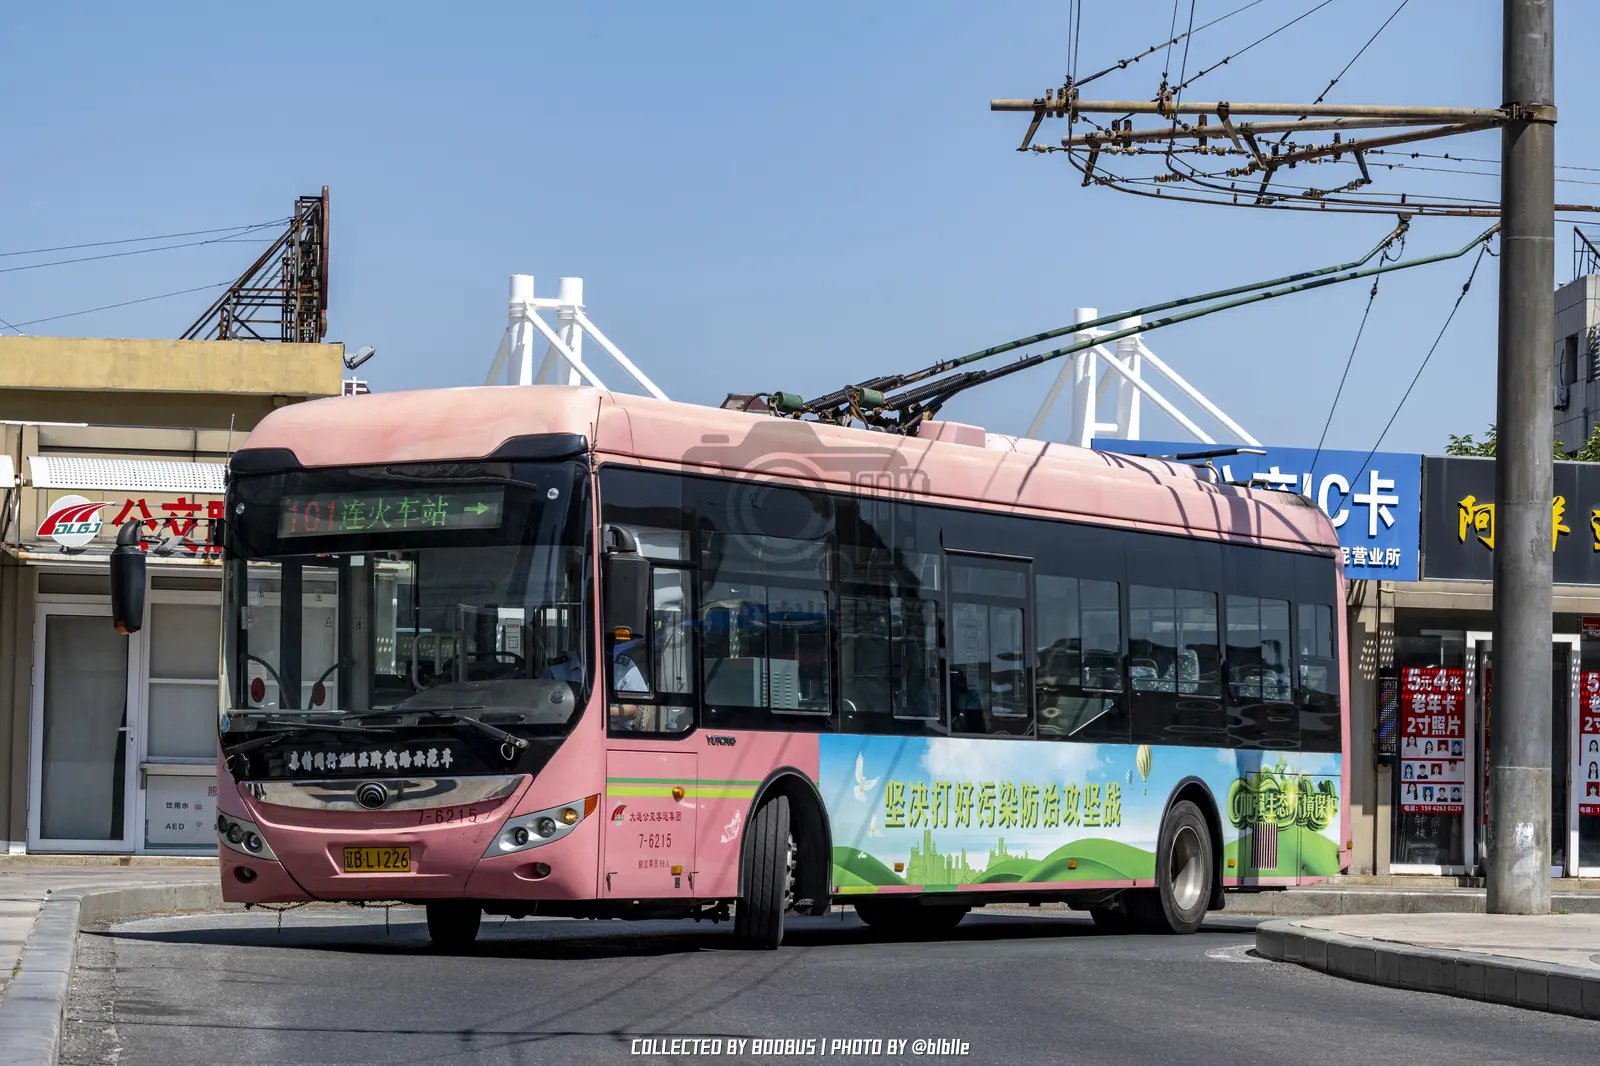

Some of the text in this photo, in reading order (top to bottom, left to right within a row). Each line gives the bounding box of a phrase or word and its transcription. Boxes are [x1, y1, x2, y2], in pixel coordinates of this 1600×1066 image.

[1407, 668, 1461, 691] 5元4张
[1412, 693, 1456, 713] 老年卡
[1407, 715, 1461, 735] 2寸照片
[884, 779, 1122, 829] 坚决打好污染防治攻坚战
[416, 809, 477, 824] 7-6215
[639, 833, 672, 848] 7-6215
